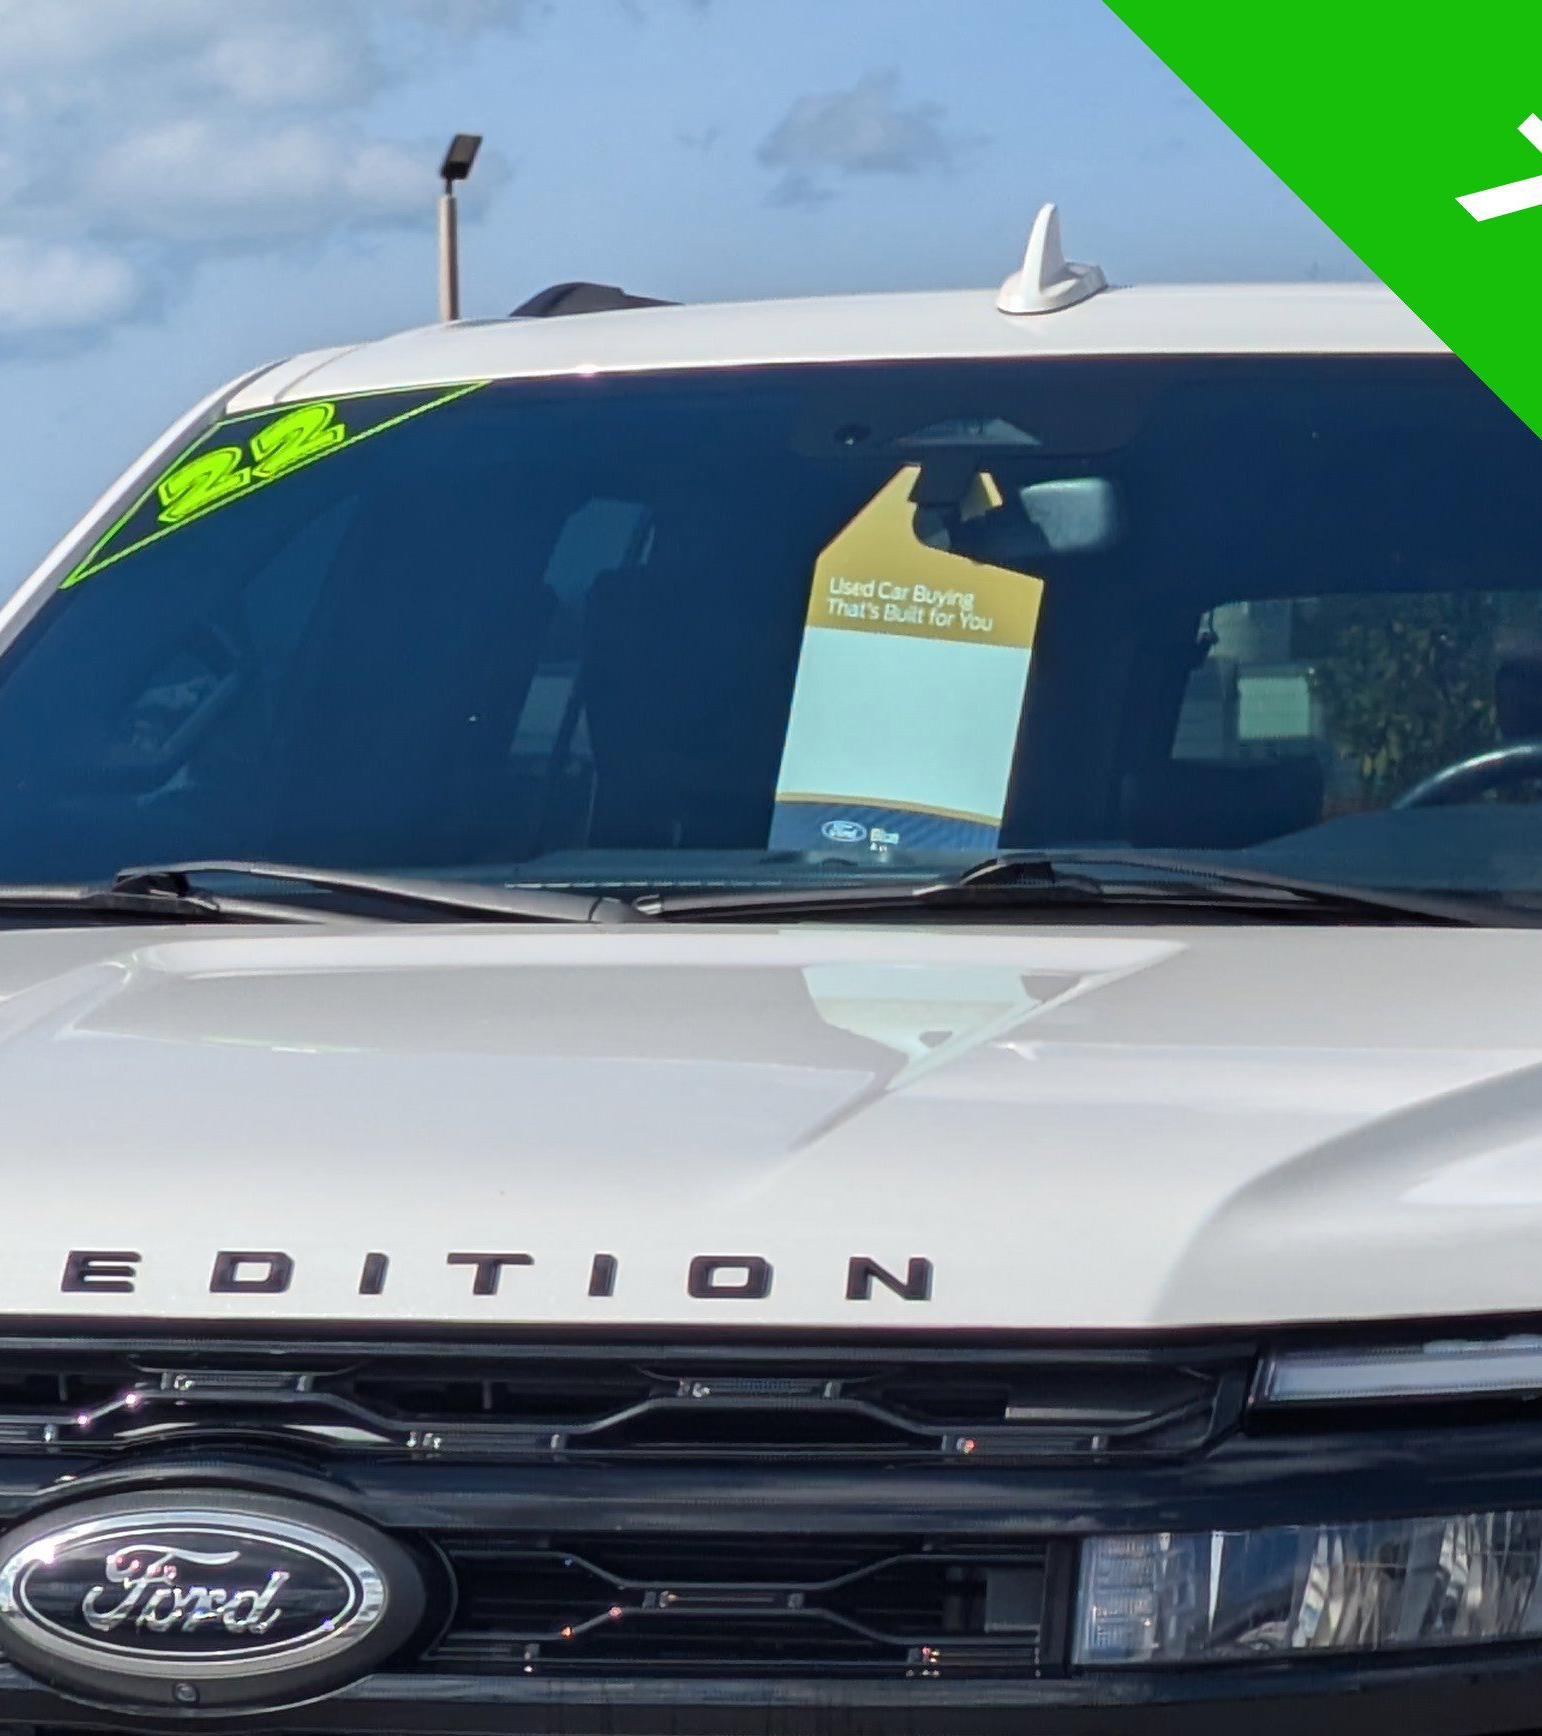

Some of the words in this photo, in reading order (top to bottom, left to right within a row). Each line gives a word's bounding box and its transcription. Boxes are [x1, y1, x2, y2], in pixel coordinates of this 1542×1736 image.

[157, 402, 346, 523] 22
[827, 598, 880, 620] That's
[883, 604, 924, 625] Built
[929, 608, 956, 627] for
[960, 612, 994, 632] You
[829, 576, 875, 598] Used
[877, 581, 909, 601] Car
[912, 584, 975, 612] Buying
[81, 1542, 292, 1636] Ford
